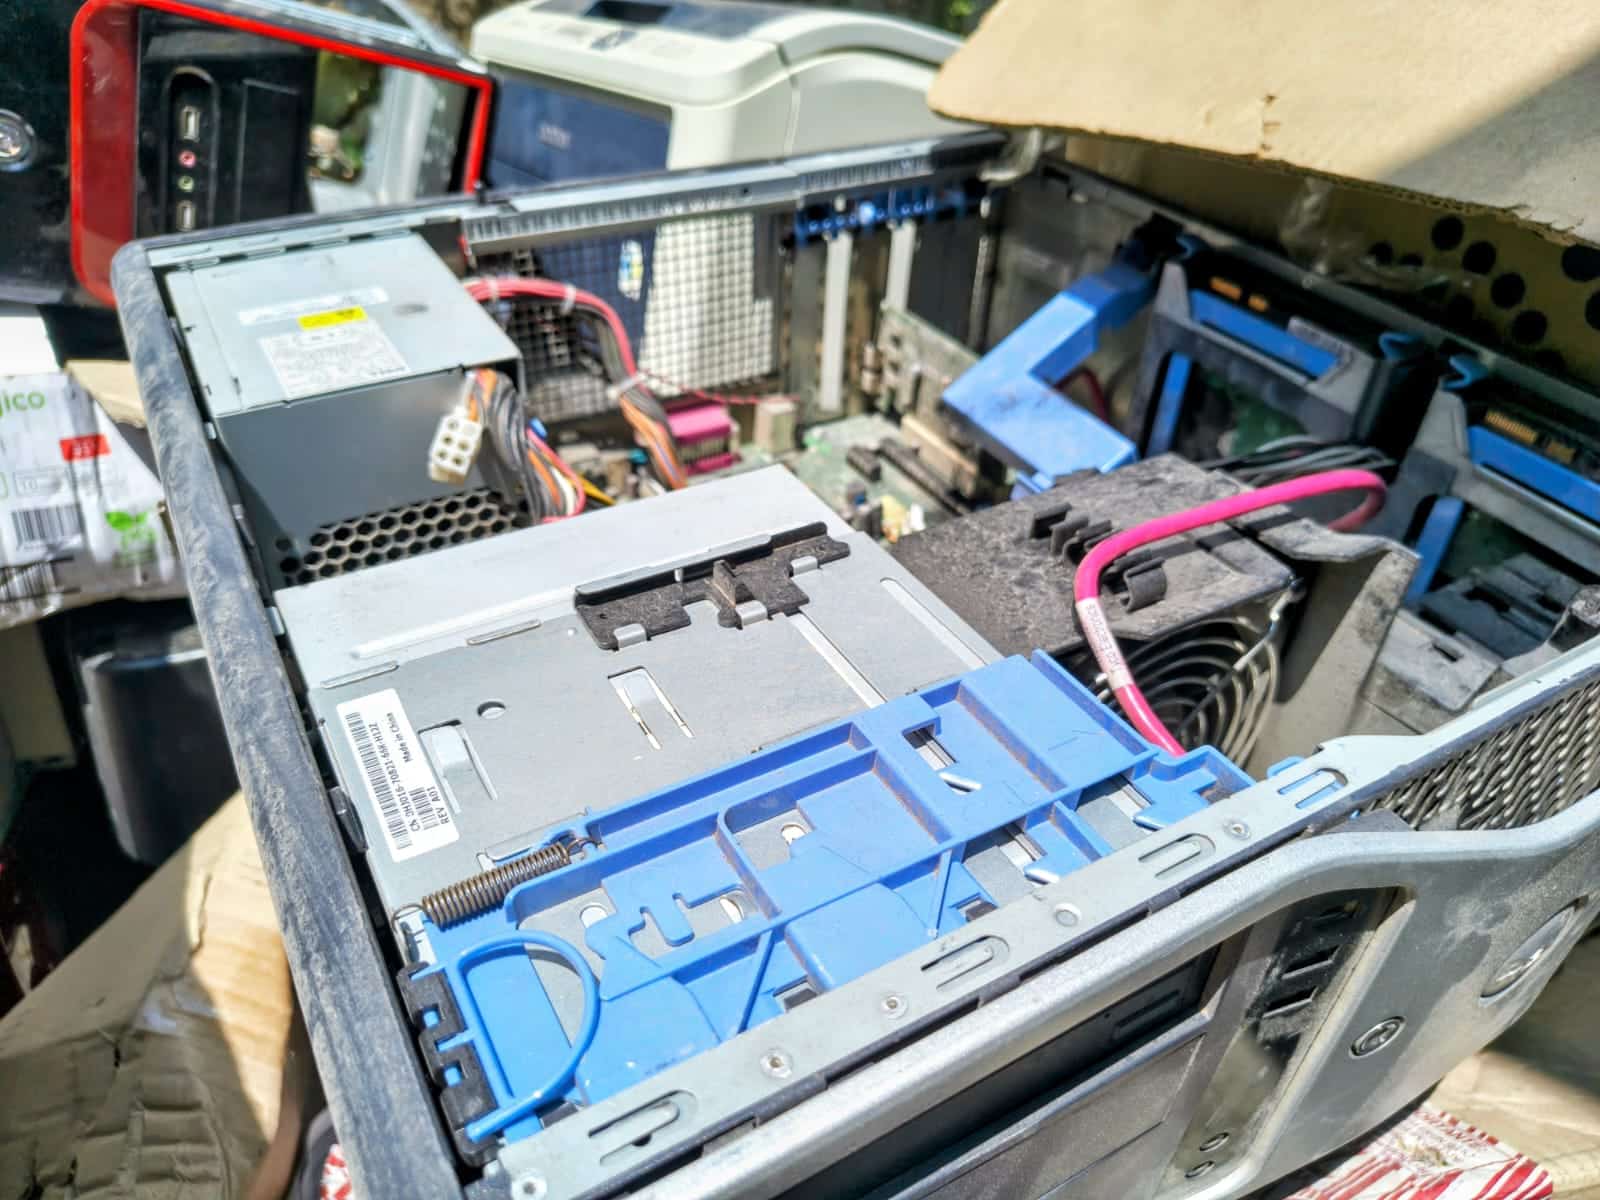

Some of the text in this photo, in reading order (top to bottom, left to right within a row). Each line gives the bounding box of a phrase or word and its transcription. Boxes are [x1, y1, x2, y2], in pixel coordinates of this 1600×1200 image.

[0, 391, 45, 417] ico
[386, 712, 412, 762] Made in China
[426, 786, 450, 825] REV A01
